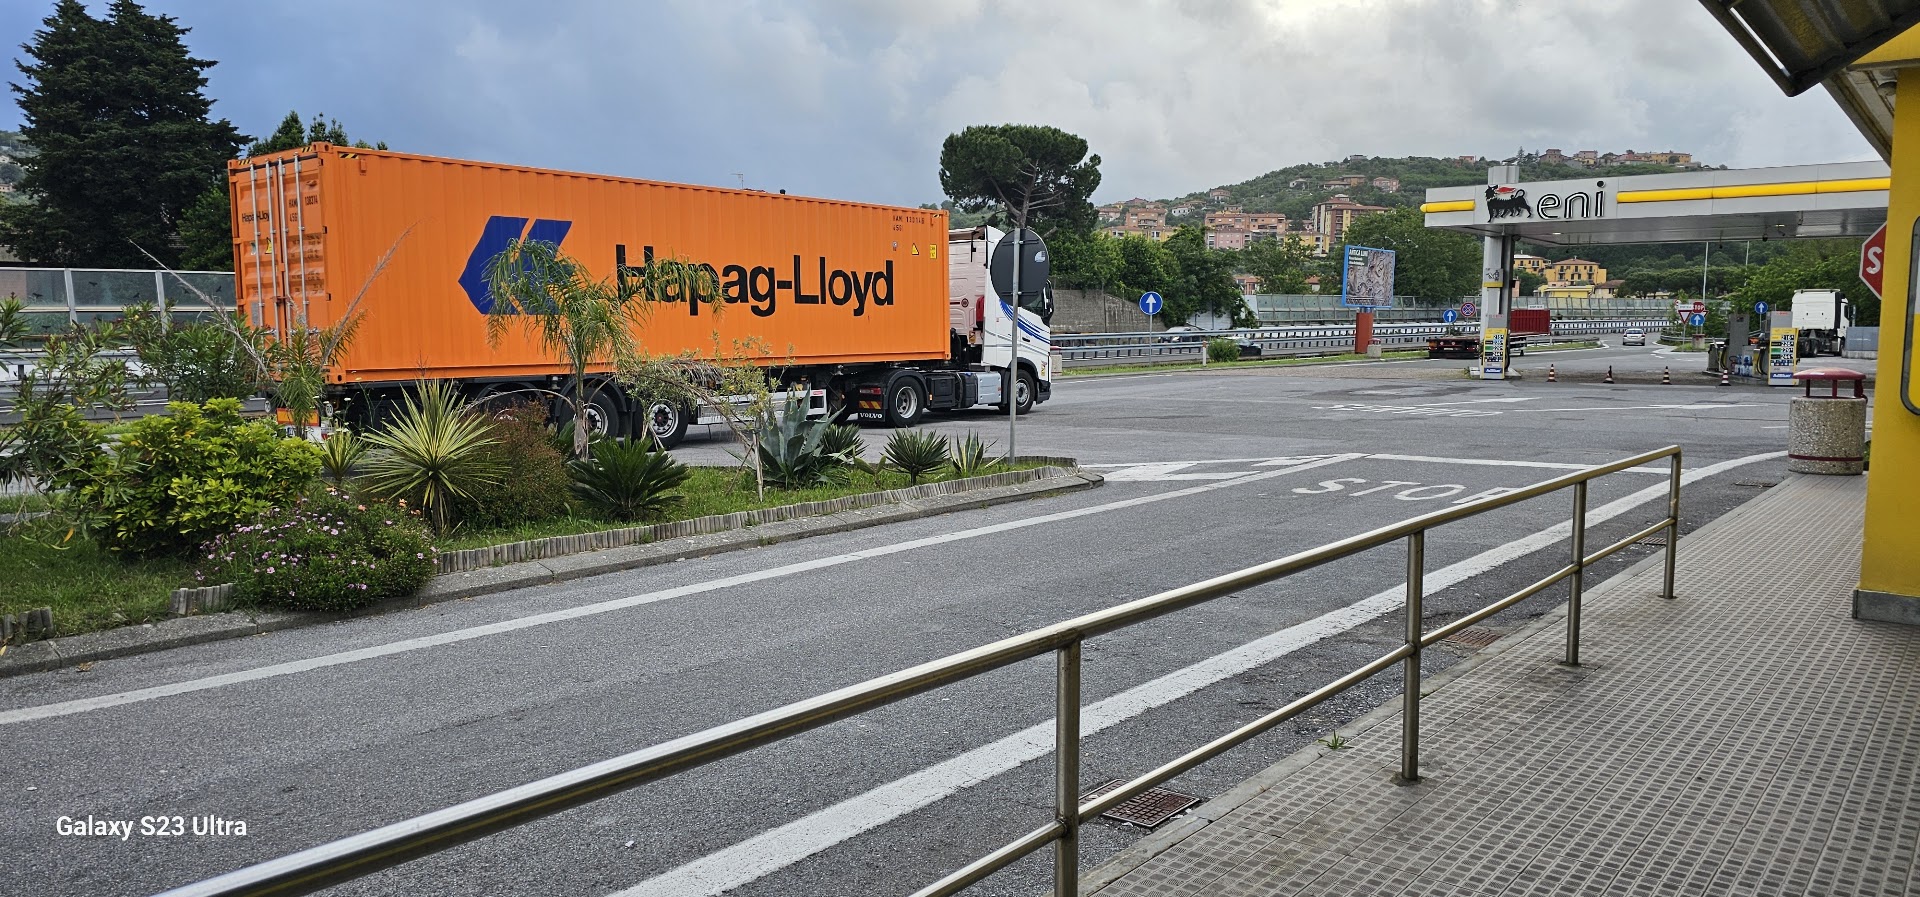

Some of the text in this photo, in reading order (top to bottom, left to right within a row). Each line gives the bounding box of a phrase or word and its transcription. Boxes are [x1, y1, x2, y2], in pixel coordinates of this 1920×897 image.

[242, 211, 270, 223] Hapa-Lloy
[1537, 181, 1605, 220] eni
[616, 244, 893, 317] Hapag-Lloyd
